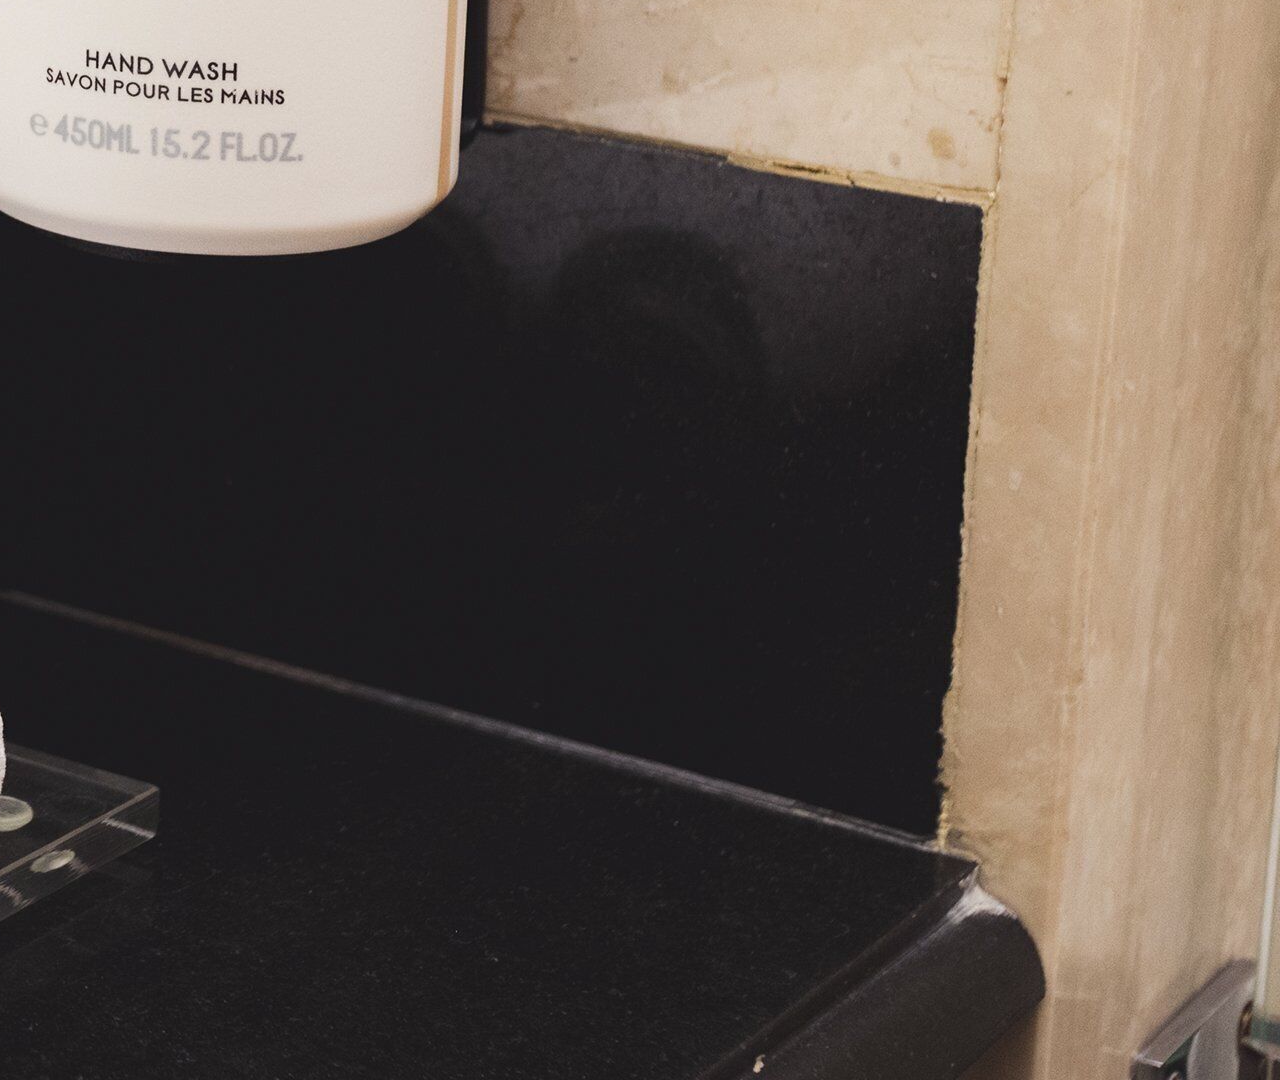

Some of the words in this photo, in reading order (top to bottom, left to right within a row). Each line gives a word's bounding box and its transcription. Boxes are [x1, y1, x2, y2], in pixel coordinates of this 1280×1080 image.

[85, 49, 154, 76] HAND
[162, 58, 238, 82] WASH
[46, 67, 106, 93] SAVON
[113, 79, 170, 101] POUR
[177, 86, 214, 104] LES
[221, 88, 285, 106] MAINS
[53, 113, 140, 155] 450ML
[150, 127, 211, 161] 15.2
[220, 131, 303, 162] FL.OZ.
